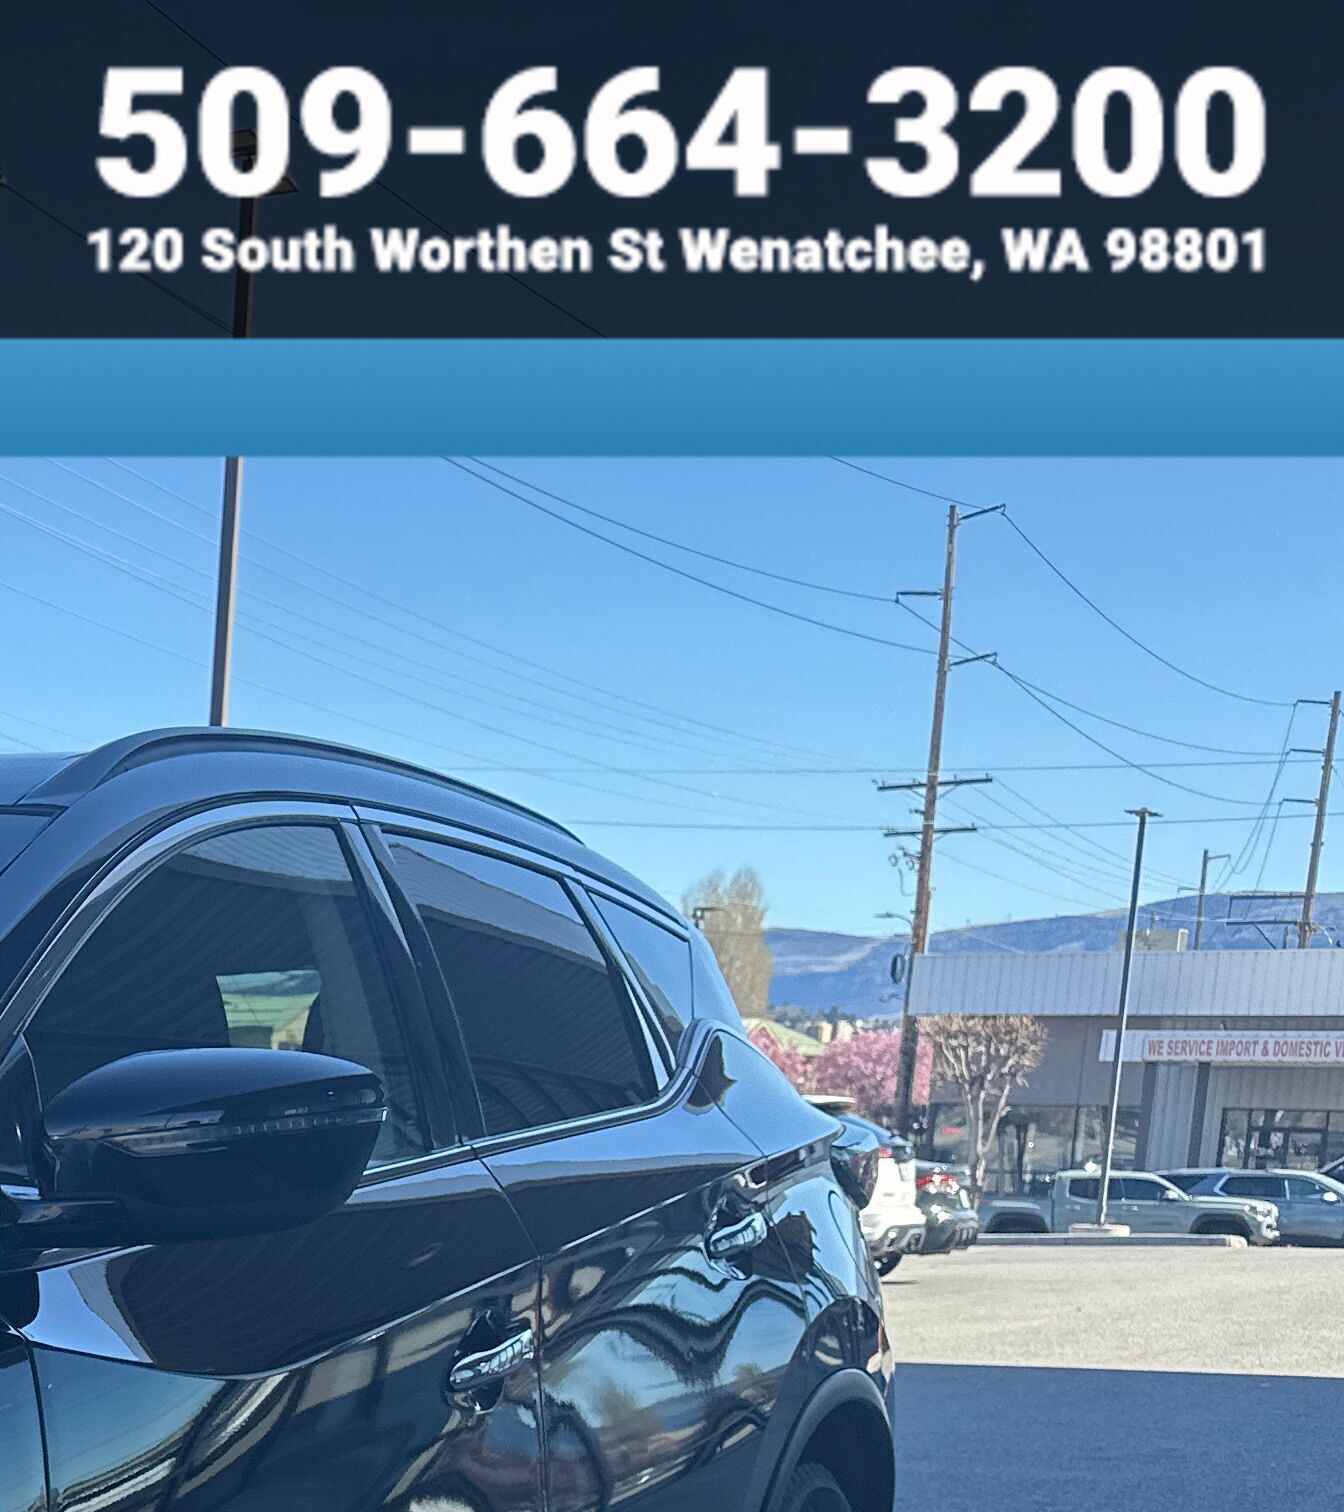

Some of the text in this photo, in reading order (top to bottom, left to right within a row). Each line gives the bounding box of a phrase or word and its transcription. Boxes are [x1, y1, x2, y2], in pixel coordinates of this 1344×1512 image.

[1148, 1040, 1164, 1056] WE
[1167, 1040, 1213, 1056] SERVICE
[1216, 1040, 1259, 1057] IMPORT
[1273, 1040, 1332, 1057] DOMESTIC
